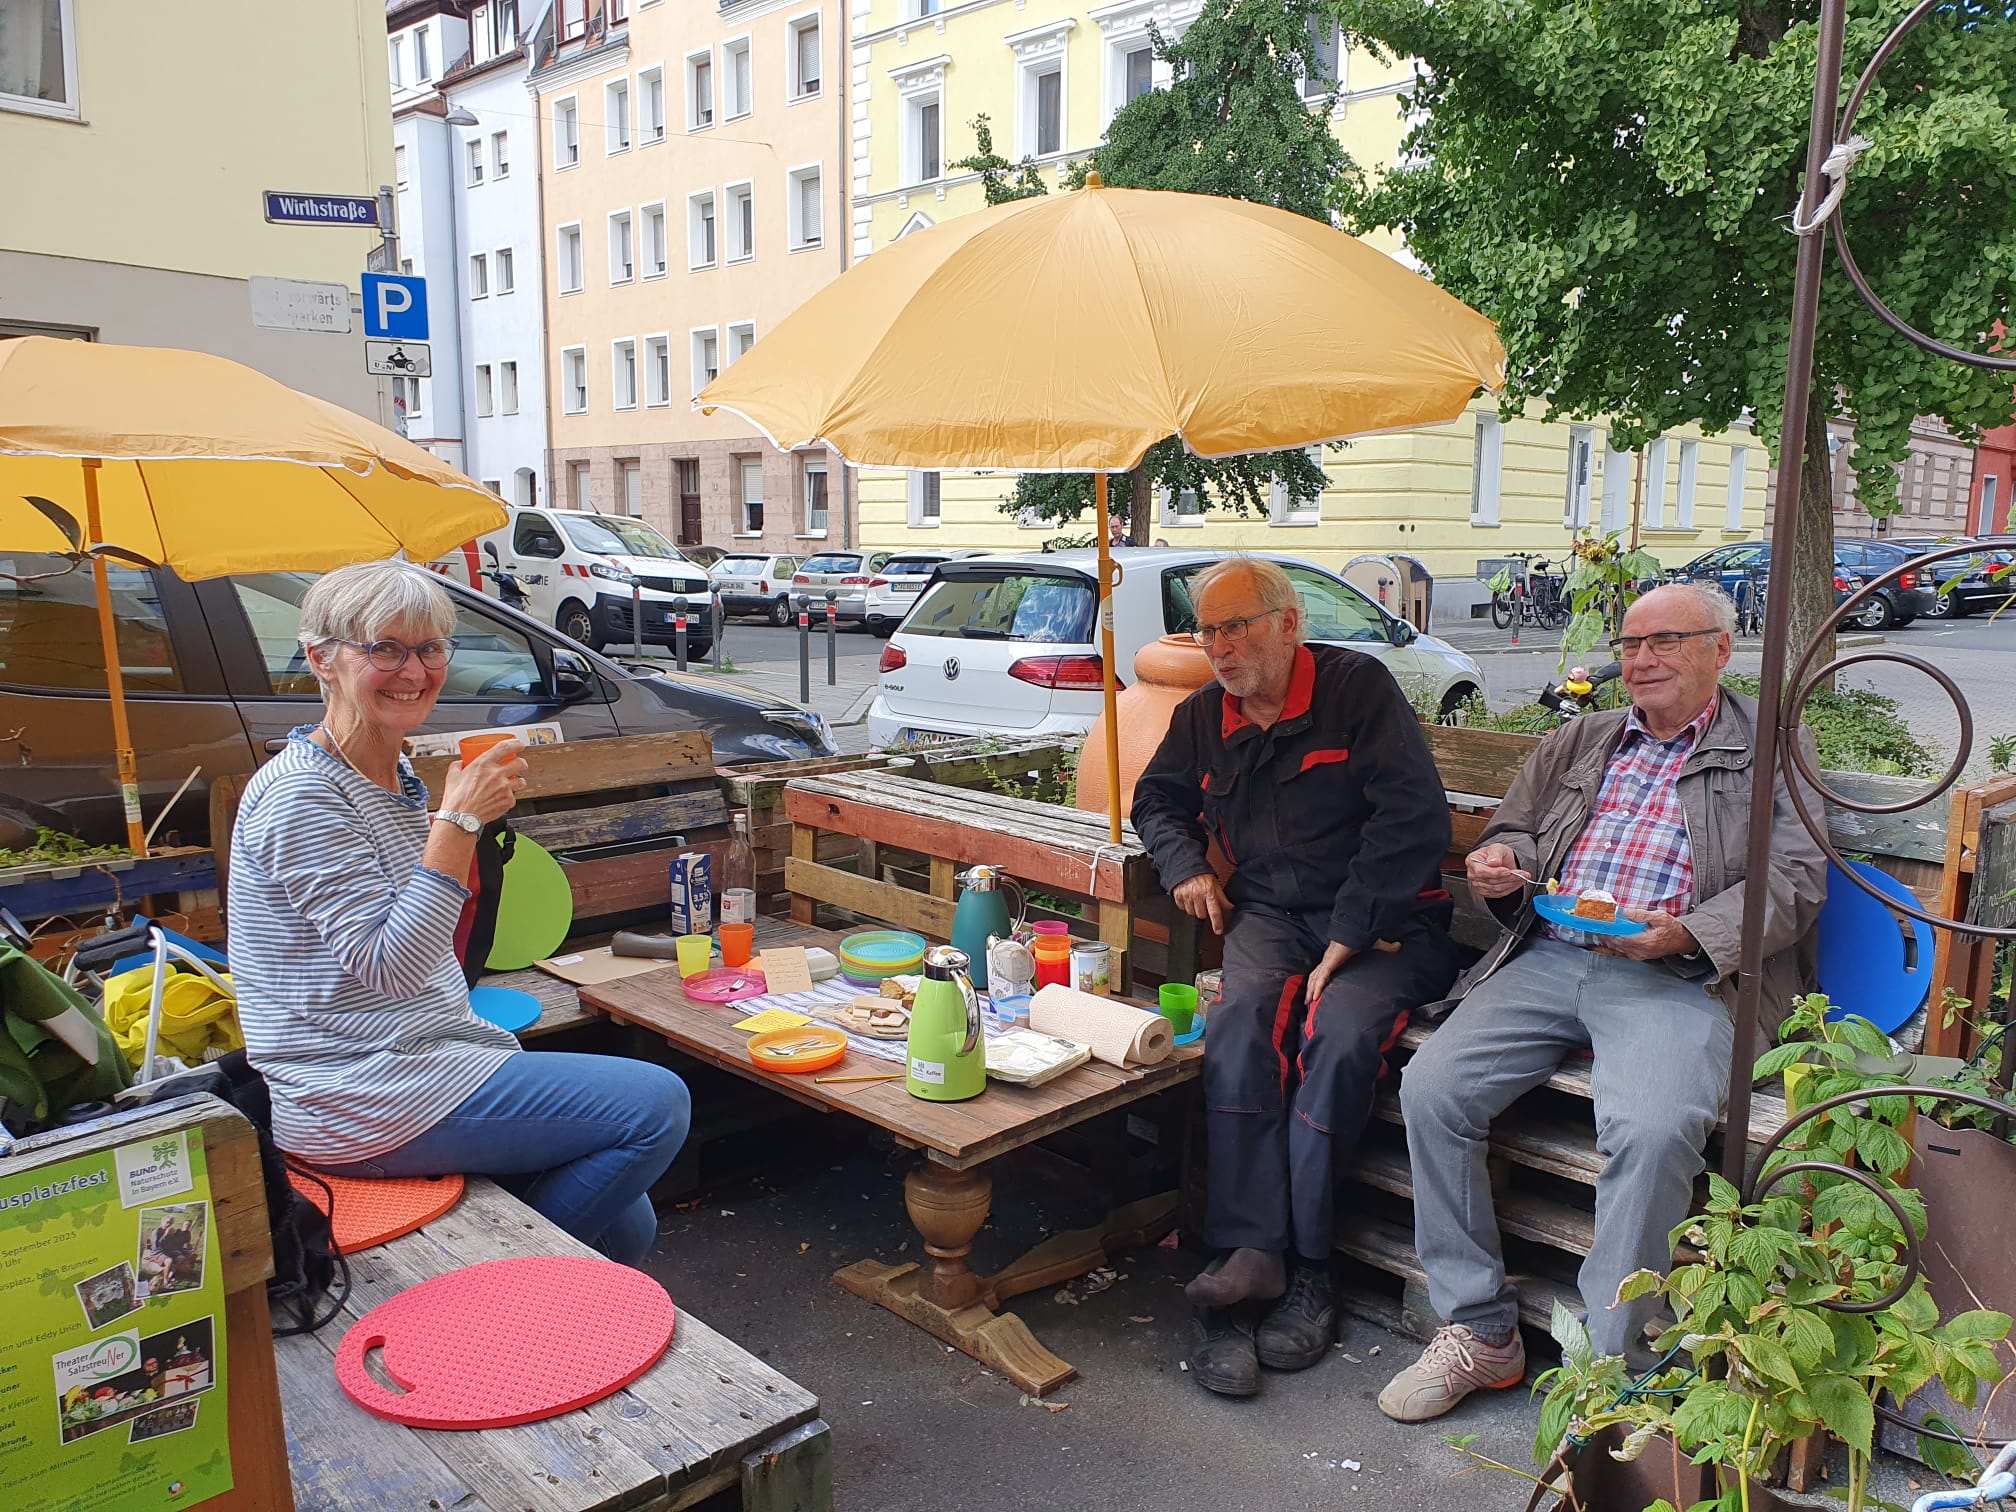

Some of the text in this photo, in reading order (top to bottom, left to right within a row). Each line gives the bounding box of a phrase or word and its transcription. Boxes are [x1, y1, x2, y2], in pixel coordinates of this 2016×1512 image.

[279, 198, 367, 221] Wirthstraße
[377, 282, 412, 330] P
[672, 579, 686, 592] FIAT
[129, 1165, 157, 1179] BUND
[130, 1169, 178, 1187] Naturschutz
[141, 1181, 167, 1193] Bayern
[2, 1231, 77, 1257] September 2025
[5, 1258, 21, 1268] Uhr
[61, 1257, 98, 1273] Brunnen
[16, 1337, 33, 1349] und
[36, 1331, 58, 1342] Eddy
[56, 1354, 89, 1370] Theater
[67, 1347, 125, 1377] SalzstreuNer
